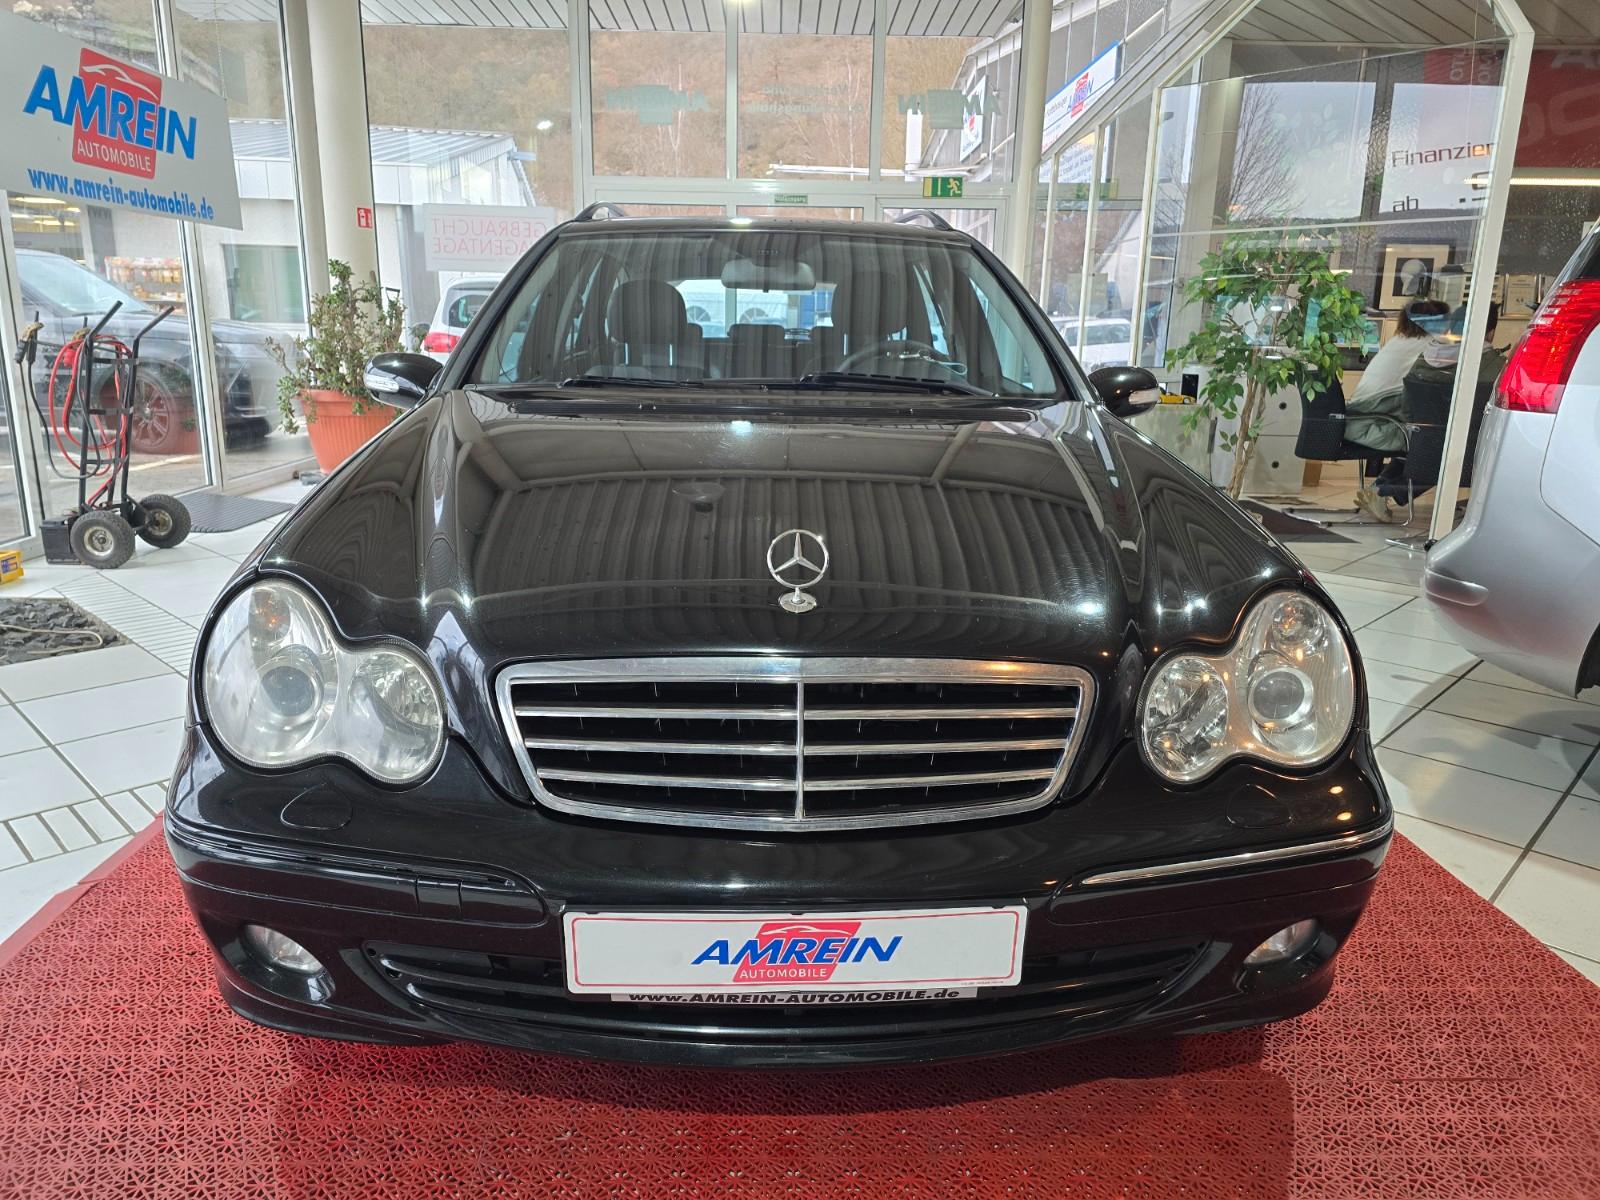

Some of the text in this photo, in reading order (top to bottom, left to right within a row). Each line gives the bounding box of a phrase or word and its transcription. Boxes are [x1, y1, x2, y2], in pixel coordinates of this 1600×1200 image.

[23, 65, 197, 160] AMREIN
[77, 137, 152, 173] AUTOMOBILE
[27, 168, 215, 220] www.amrein-automobile.de
[1392, 196, 1419, 213] ab
[691, 935, 903, 966] AMREIN
[739, 968, 828, 980] AUTOMOBILE
[627, 988, 960, 1004] www.AMREIN-AUTOMOBILE.de
